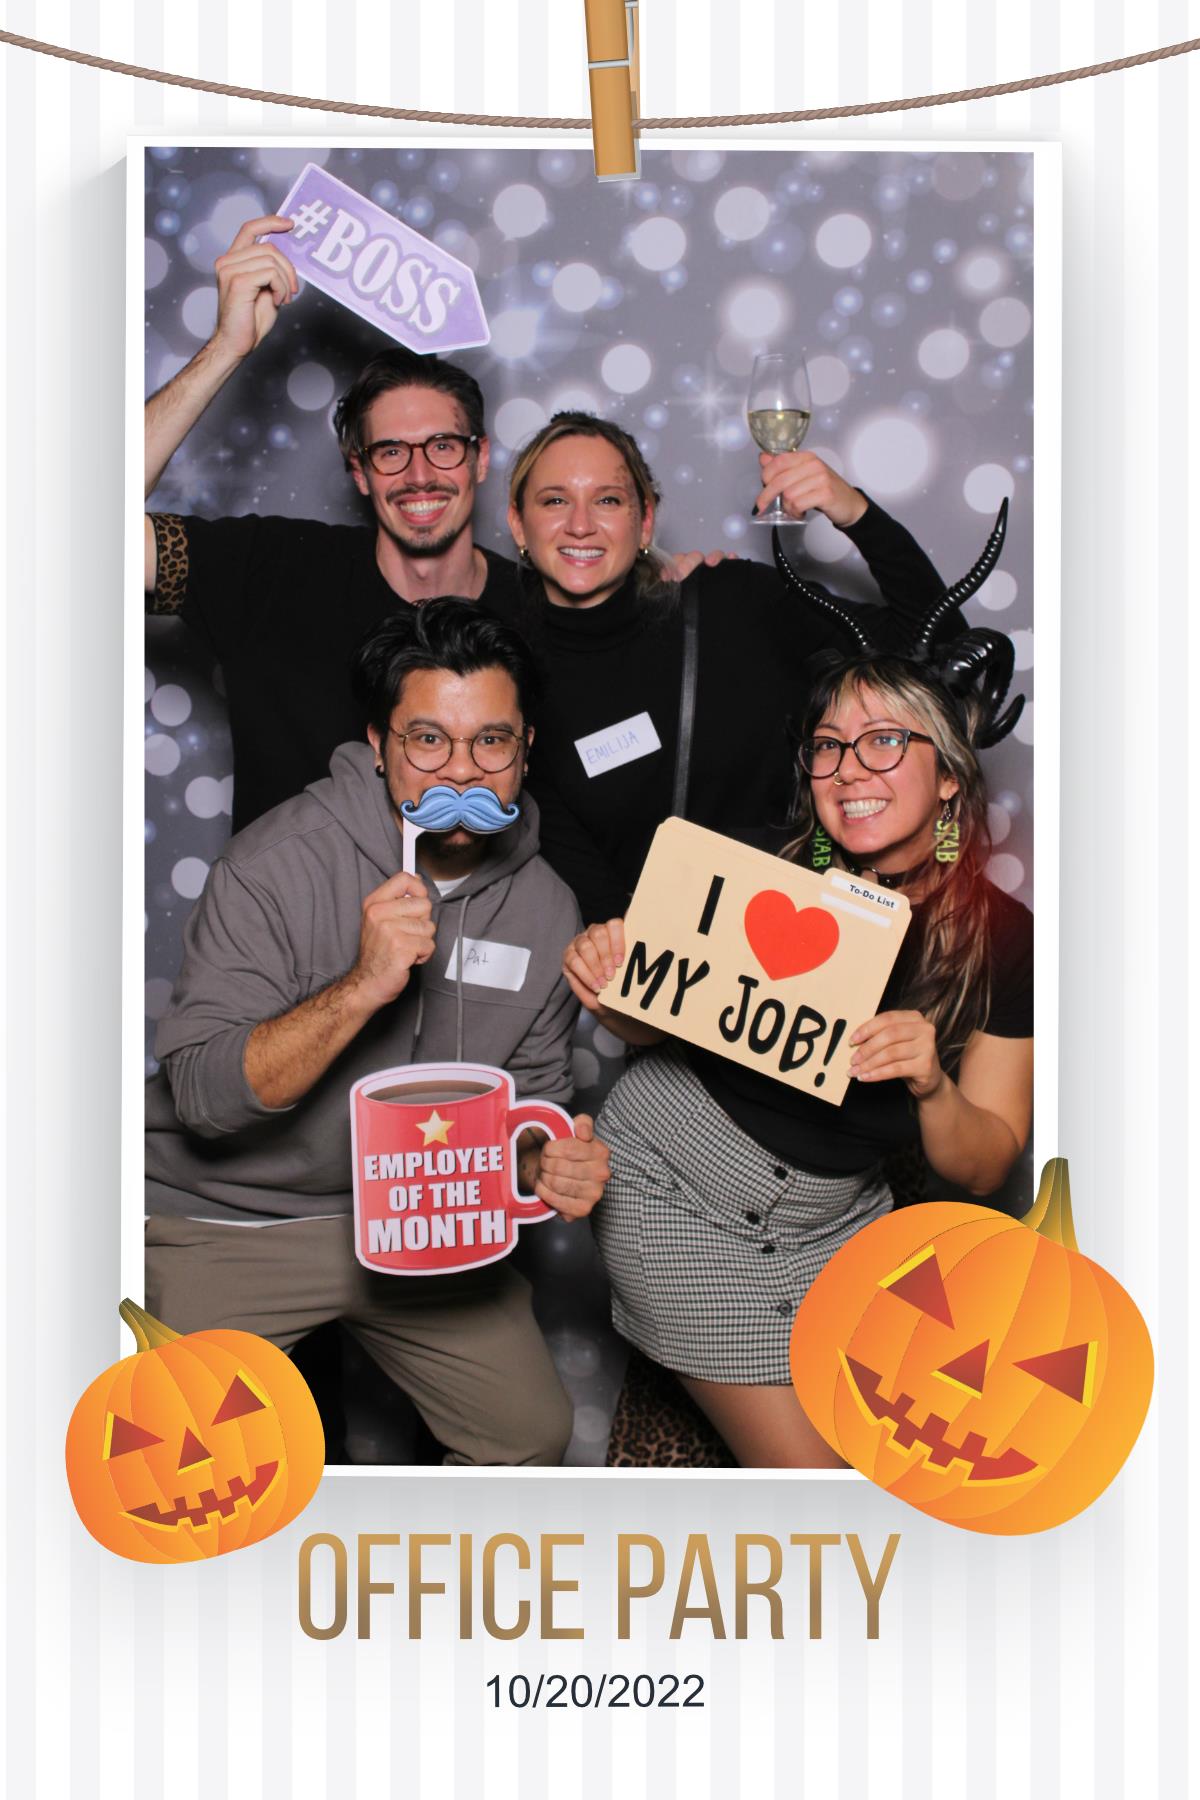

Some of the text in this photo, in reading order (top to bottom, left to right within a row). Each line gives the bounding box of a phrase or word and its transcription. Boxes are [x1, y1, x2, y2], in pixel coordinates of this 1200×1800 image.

[289, 199, 461, 334] #BOSS
[697, 874, 725, 936] I
[850, 884, 896, 909] To-Do List
[620, 941, 847, 1088] MY JOB!
[364, 1145, 503, 1181] EMPLOYEE
[388, 1180, 481, 1212] OF THE
[367, 1209, 506, 1254] MONTH
